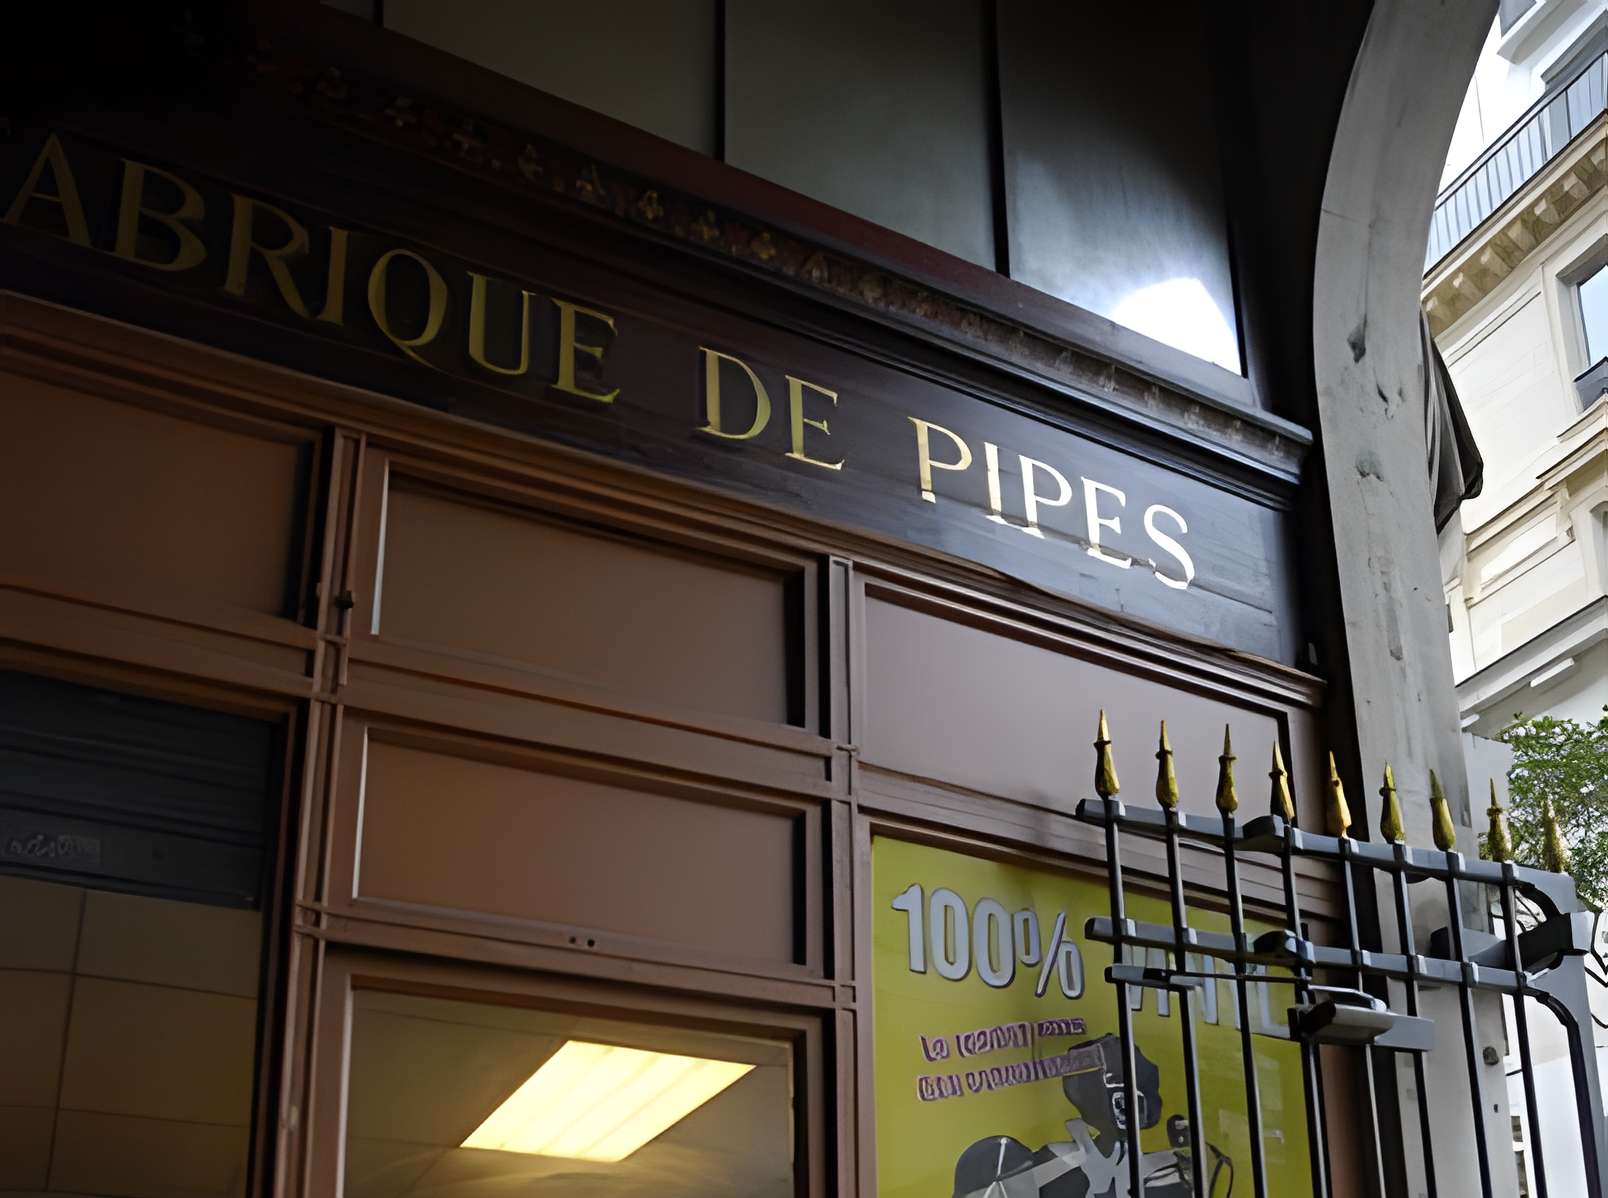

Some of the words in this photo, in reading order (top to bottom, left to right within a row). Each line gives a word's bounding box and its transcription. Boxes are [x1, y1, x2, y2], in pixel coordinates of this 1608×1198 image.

[0, 130, 620, 404] ABRIQUE
[698, 346, 845, 470] DE
[908, 416, 1197, 590] PIPES
[891, 882, 1085, 999] 100%
